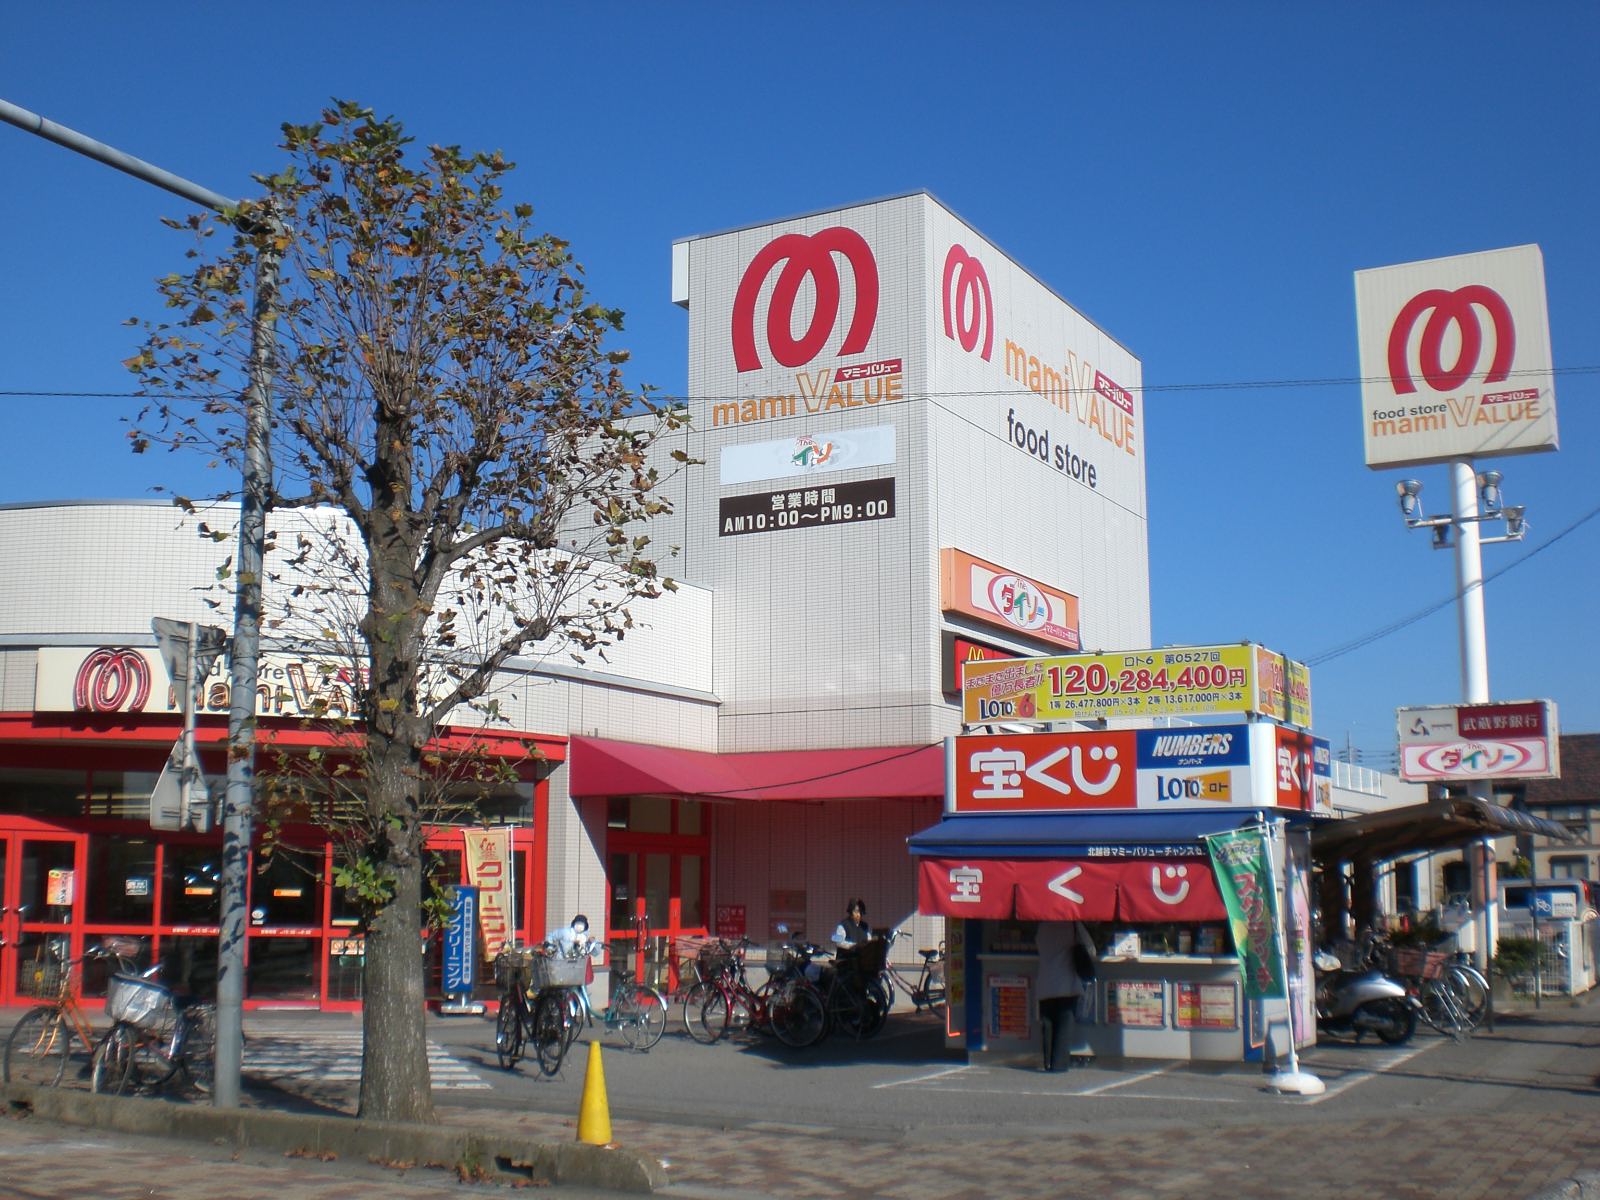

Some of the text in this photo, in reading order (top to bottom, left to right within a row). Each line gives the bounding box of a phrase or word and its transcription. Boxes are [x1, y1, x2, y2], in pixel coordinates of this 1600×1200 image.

[842, 364, 899, 378] マミーバリュー
[713, 368, 904, 427] mami VALUE
[1005, 337, 1136, 457] mami VALUE
[1372, 402, 1447, 421] food store
[1372, 396, 1542, 437] mami VALUE
[1007, 408, 1097, 489] food store
[771, 487, 836, 511] 営業時間
[1001, 583, 1045, 624] ダイソー
[1124, 651, 1221, 667] ロト6 第0527回
[1047, 663, 1247, 698] 120,284,400円
[1462, 714, 1539, 731] 武蔵野銀行
[1152, 733, 1233, 757] NUMBERS
[1440, 747, 1516, 770] ダイソー
[970, 745, 1122, 799] 宝くじ
[1156, 775, 1200, 802] LOTO
[1087, 846, 1206, 857] 北越谷マミーバリューチャンスセ
[1232, 871, 1274, 993] スクラッチ
